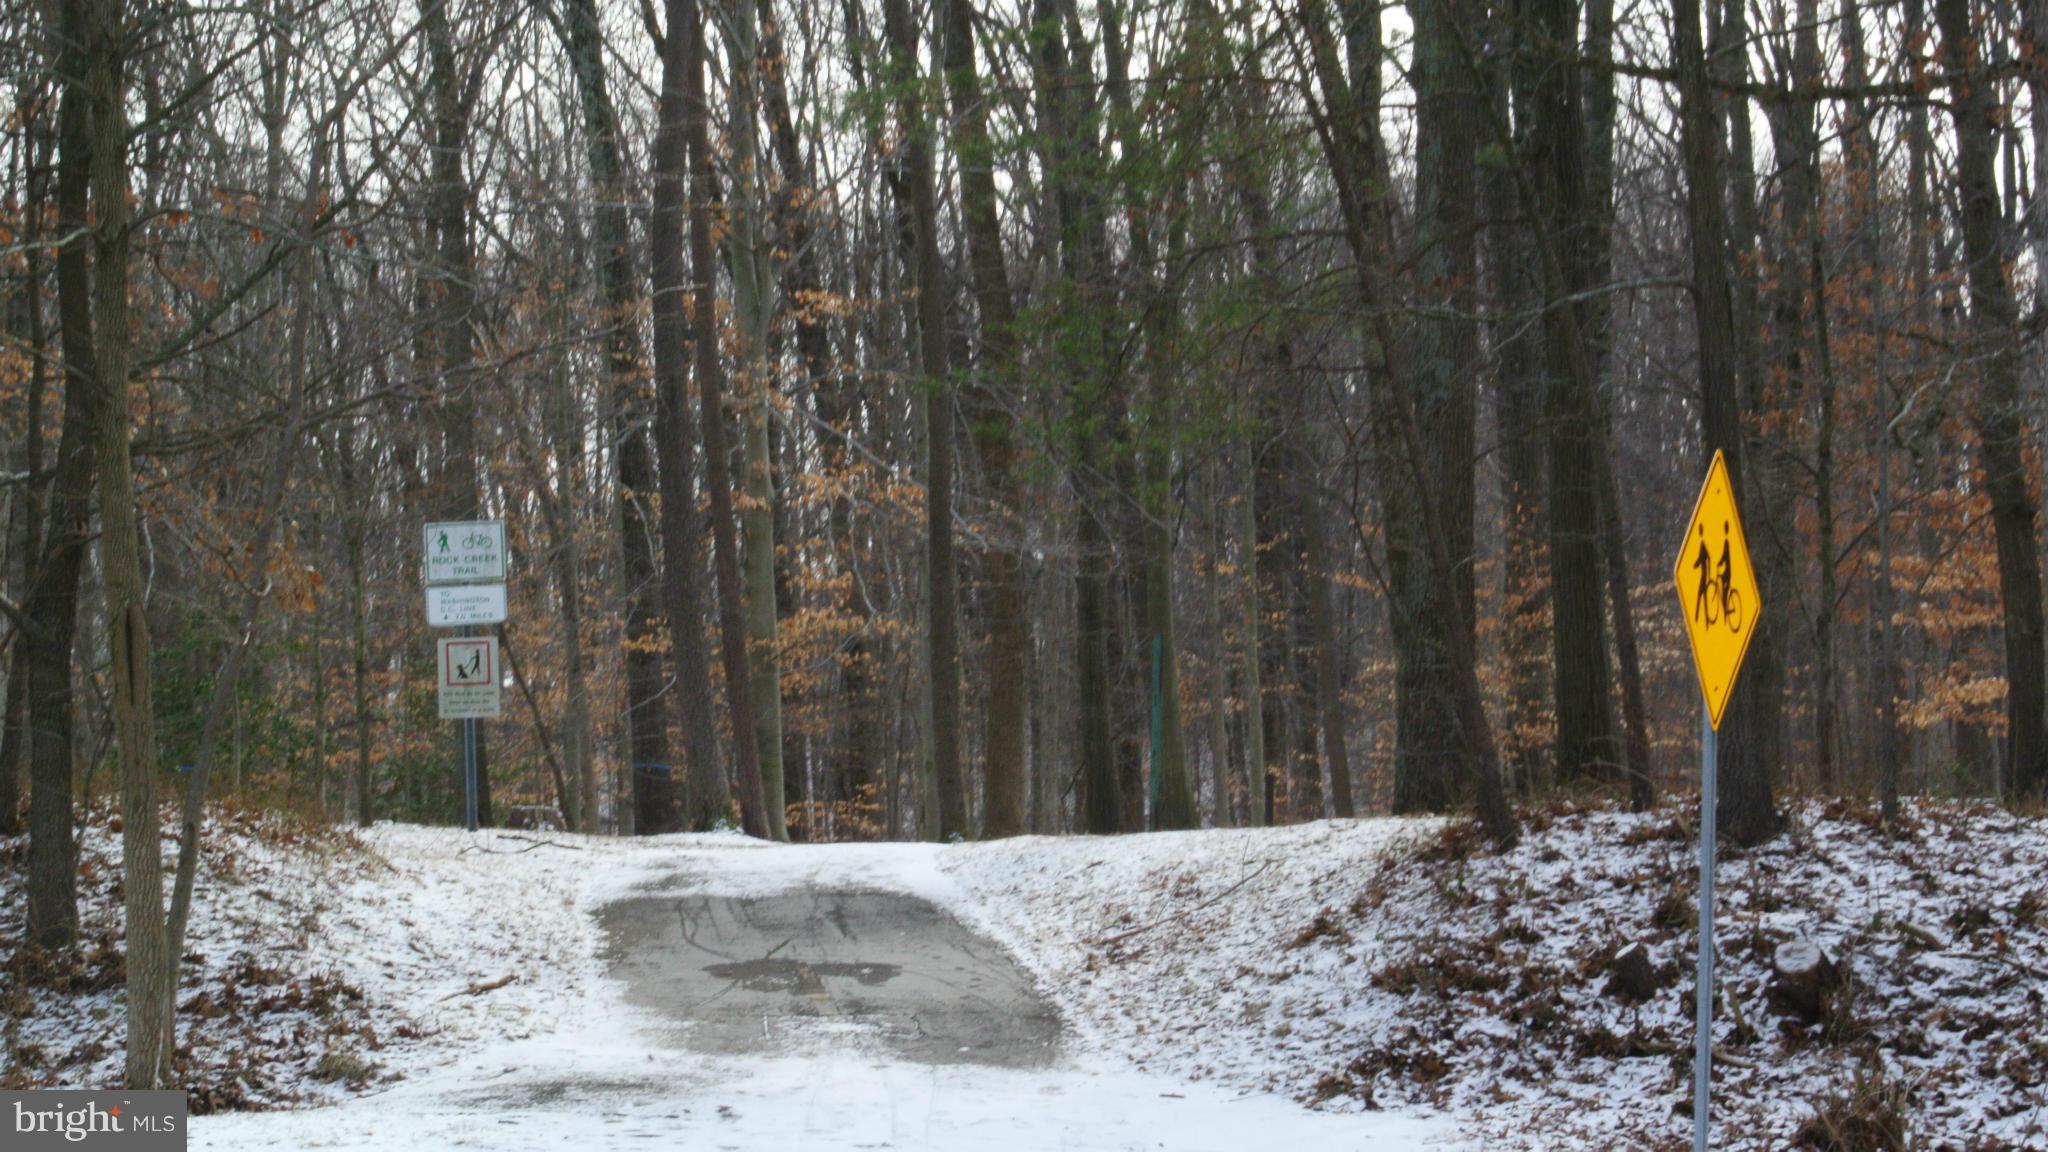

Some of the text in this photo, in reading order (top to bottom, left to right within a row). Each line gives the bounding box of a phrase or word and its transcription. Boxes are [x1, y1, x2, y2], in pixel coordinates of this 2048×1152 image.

[432, 553, 497, 565] ROCK CREEK
[452, 566, 479, 576] TRAIL
